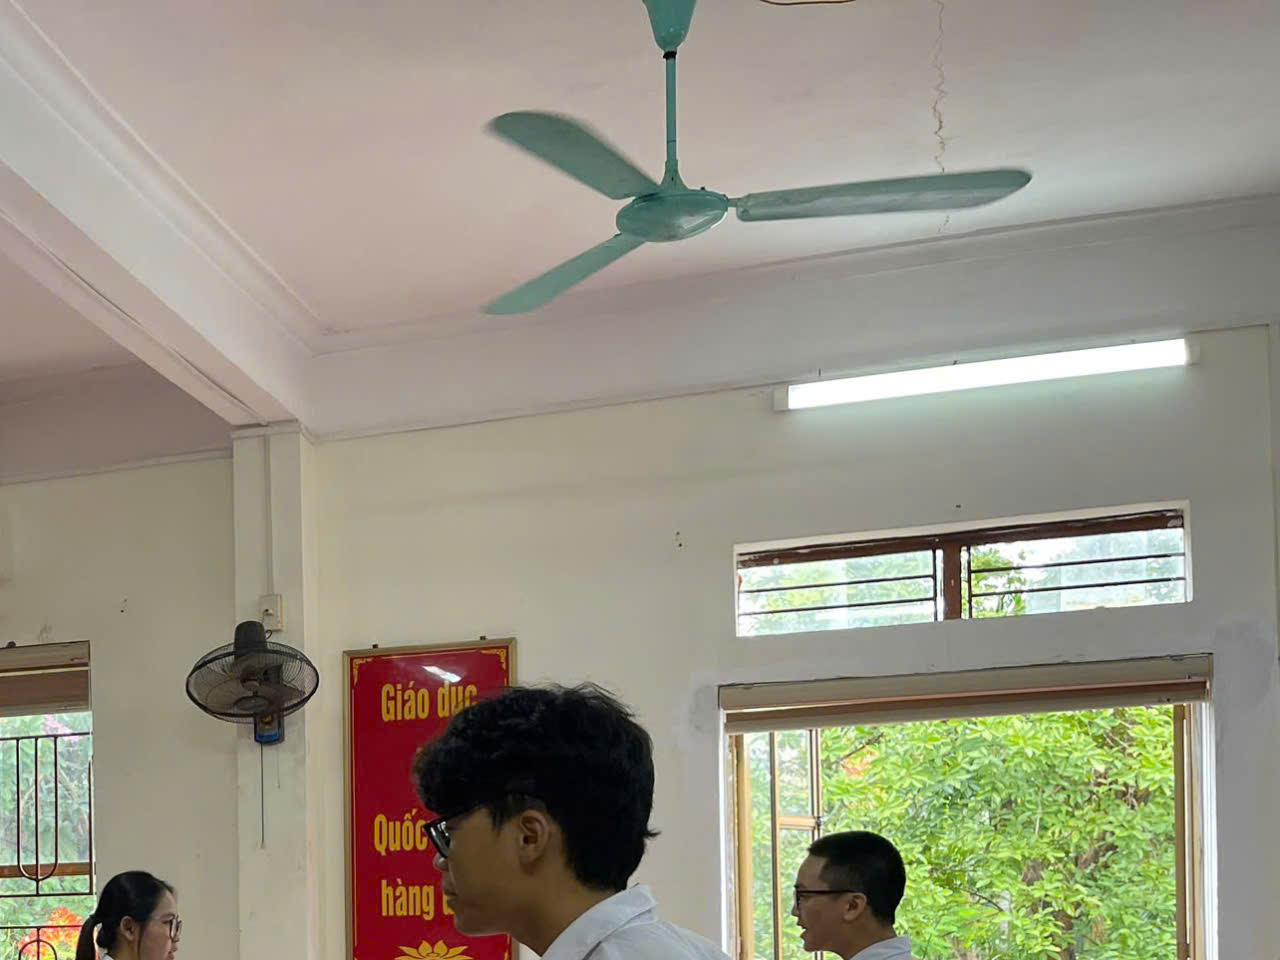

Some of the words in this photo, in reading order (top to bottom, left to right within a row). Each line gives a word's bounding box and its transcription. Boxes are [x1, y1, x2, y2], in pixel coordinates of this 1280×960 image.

[381, 681, 430, 722] Giáo
[374, 808, 428, 856] Quốc
[381, 878, 435, 920] hàng
